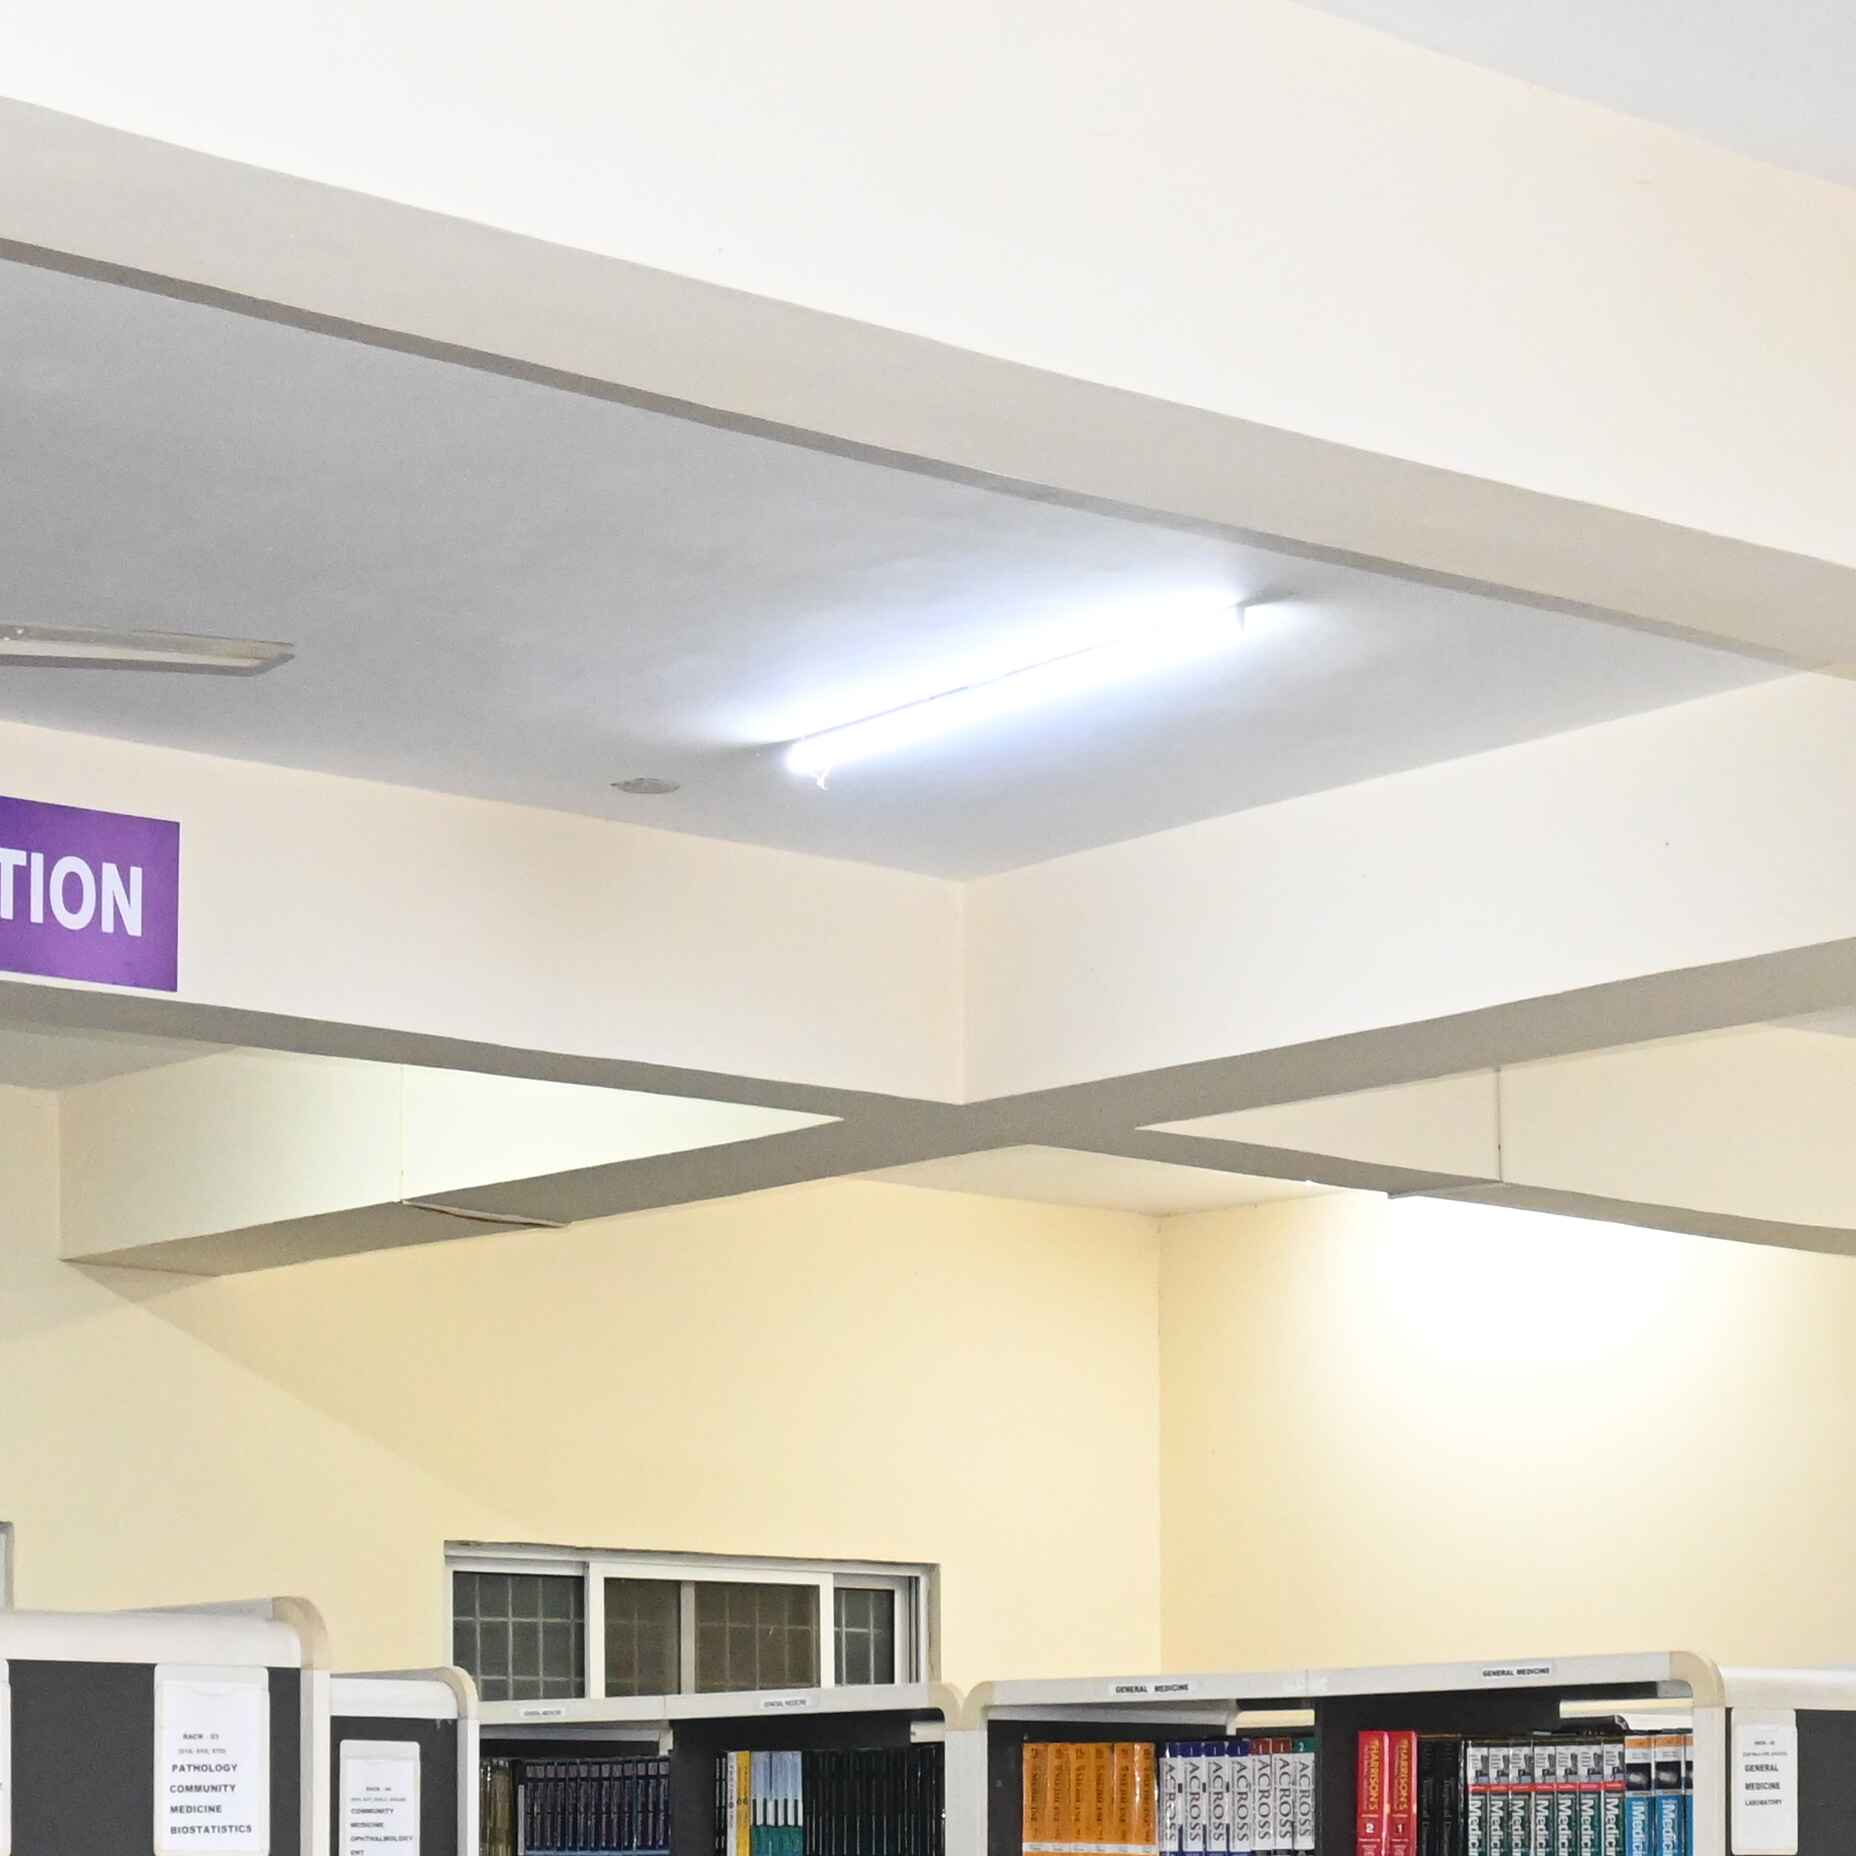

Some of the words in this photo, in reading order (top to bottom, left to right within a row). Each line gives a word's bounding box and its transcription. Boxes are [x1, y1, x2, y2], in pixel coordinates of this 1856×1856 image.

[1483, 1669, 1514, 1677] GENERAL
[1516, 1667, 1549, 1675] MEDICINE
[1115, 1685, 1147, 1694] GENERAL
[1154, 1684, 1188, 1692] MEDICINE
[172, 1763, 238, 1773] PATHOLOGY
[1745, 1764, 1779, 1772] GENERAL
[169, 1784, 237, 1793] COMMUNITY
[1745, 1782, 1780, 1790] MEDICINE
[1189, 1762, 1201, 1842] ACROSS
[1212, 1761, 1224, 1841] ACROSS
[1236, 1761, 1249, 1842] ACROSS
[1258, 1759, 1271, 1840] ACROSS
[1279, 1758, 1292, 1839] ACROSS
[1299, 1761, 1311, 1837] ACROSS
[170, 1805, 222, 1813] MEDICINE
[170, 1825, 252, 1834] BIOSTATISTICS
